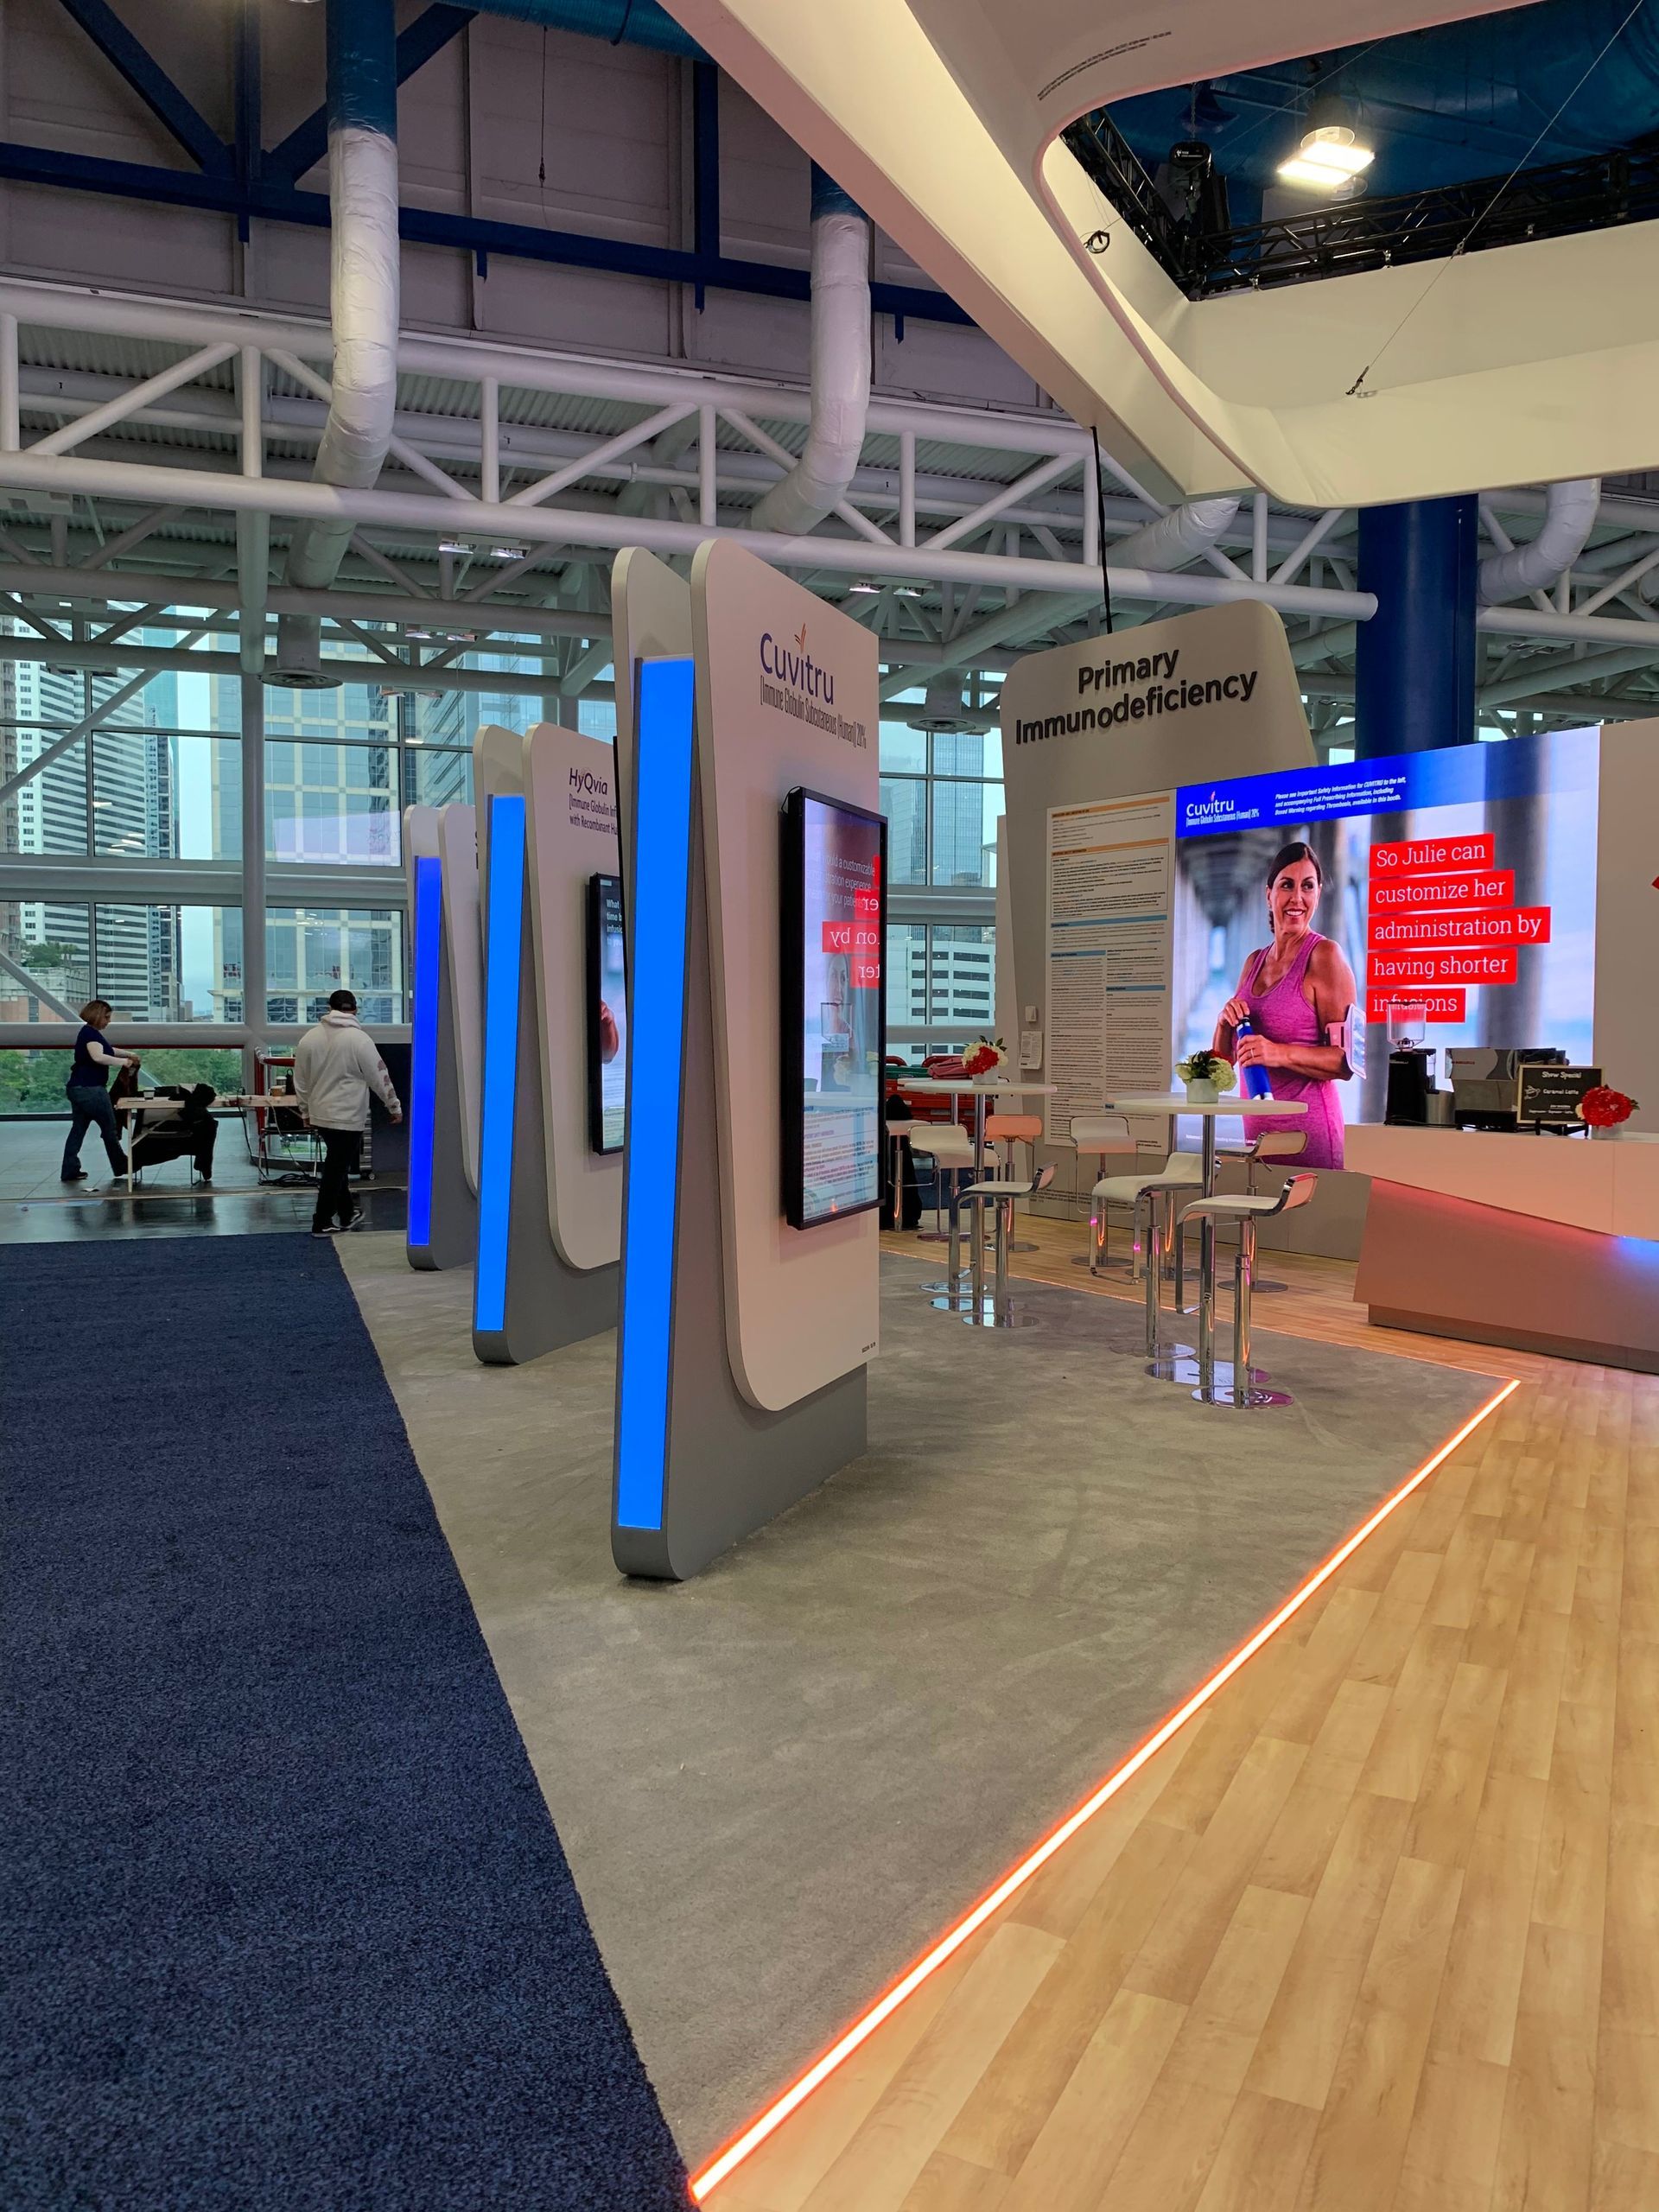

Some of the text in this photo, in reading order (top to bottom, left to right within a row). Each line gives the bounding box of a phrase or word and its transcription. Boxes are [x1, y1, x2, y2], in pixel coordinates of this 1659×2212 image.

[760, 632, 834, 705] Cuvitru
[1077, 649, 1179, 694] Primary
[785, 687, 804, 721] Globulin
[804, 697, 836, 735] Subcutaneous
[1015, 671, 1258, 745] Immunodeficiency
[569, 767, 608, 795] HyQvia
[1297, 789, 1318, 798] Important
[1332, 783, 1357, 792] Information
[590, 799, 609, 816] Globulin
[1186, 799, 1234, 817] Cuvitru
[1283, 798, 1313, 807] accompanying
[1322, 793, 1346, 802] Prescribing
[1305, 804, 1326, 812] regarding
[1351, 798, 1372, 806] available
[569, 813, 581, 827] with
[581, 815, 610, 833] Recombinant
[1376, 843, 1486, 868] So Julie can
[1375, 878, 1506, 904] customize her
[606, 899, 620, 909] What
[1374, 914, 1542, 940] administration by
[1373, 956, 1510, 979] having shorter
[1373, 993, 1458, 1012] infusions
[1560, 1071, 1582, 1080] Special
